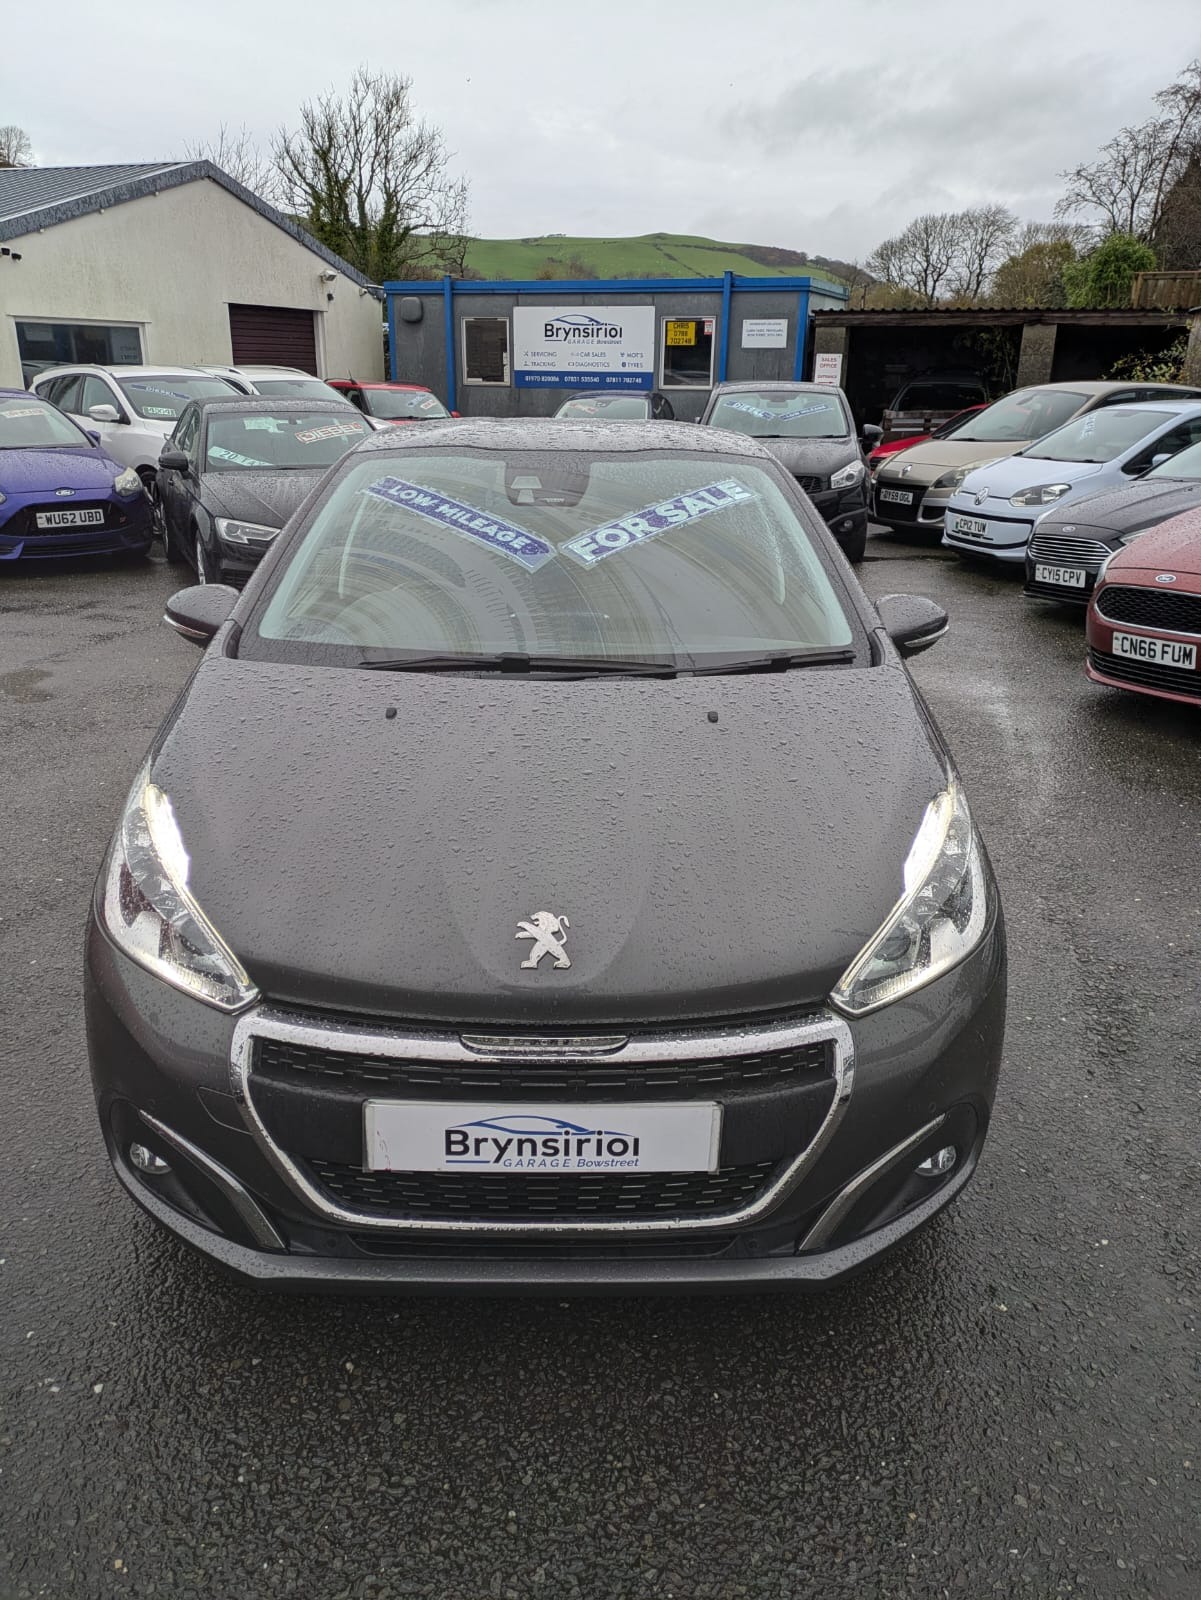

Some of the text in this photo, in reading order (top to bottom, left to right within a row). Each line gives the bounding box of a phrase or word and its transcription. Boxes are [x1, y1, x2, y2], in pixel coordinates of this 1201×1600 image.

[544, 323, 623, 341] Brynsiriol
[300, 422, 363, 441] DIESEL
[45, 510, 102, 525] WU62 UBD
[389, 486, 531, 549] LOW MILEAGE
[568, 482, 752, 561] FOR SALE
[959, 518, 987, 534] CP12 TUW
[1041, 566, 1082, 585] CY15 CPV
[1121, 636, 1194, 665] CN66 FUM
[445, 1129, 639, 1164] Brynsiriol
[503, 1157, 639, 1168] GARAGE Bowstreet
